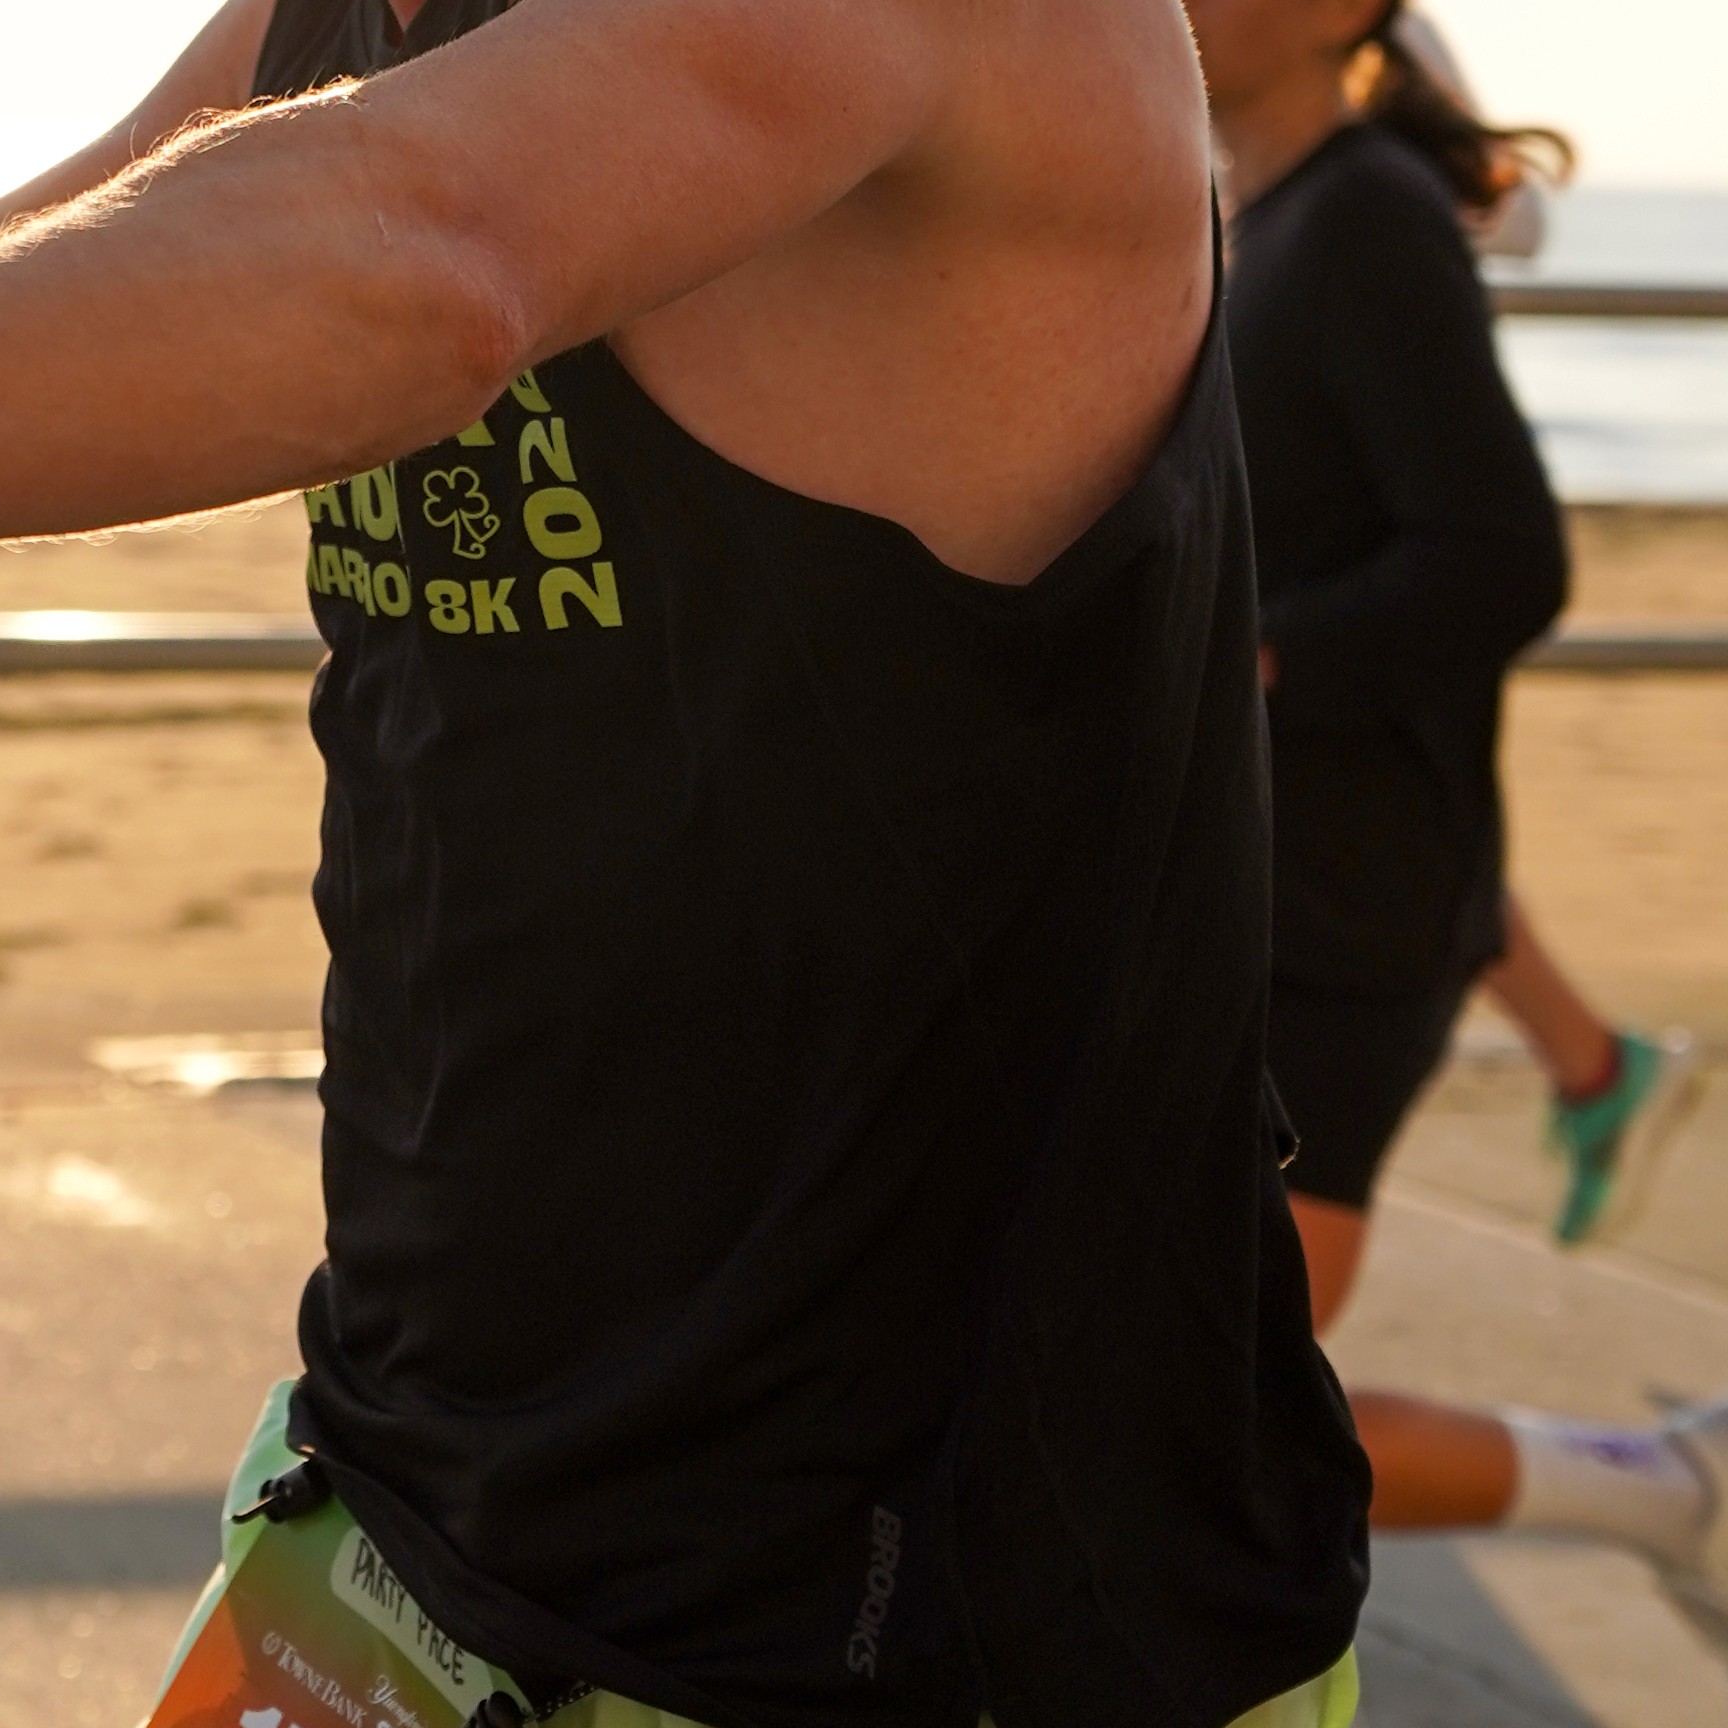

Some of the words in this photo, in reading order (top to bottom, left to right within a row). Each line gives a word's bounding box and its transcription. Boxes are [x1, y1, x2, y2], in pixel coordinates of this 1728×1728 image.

[424, 577, 520, 635] 8K
[350, 1535, 407, 1624] PARTY
[416, 1609, 465, 1686] PACE
[846, 1504, 902, 1681] BROOKS
